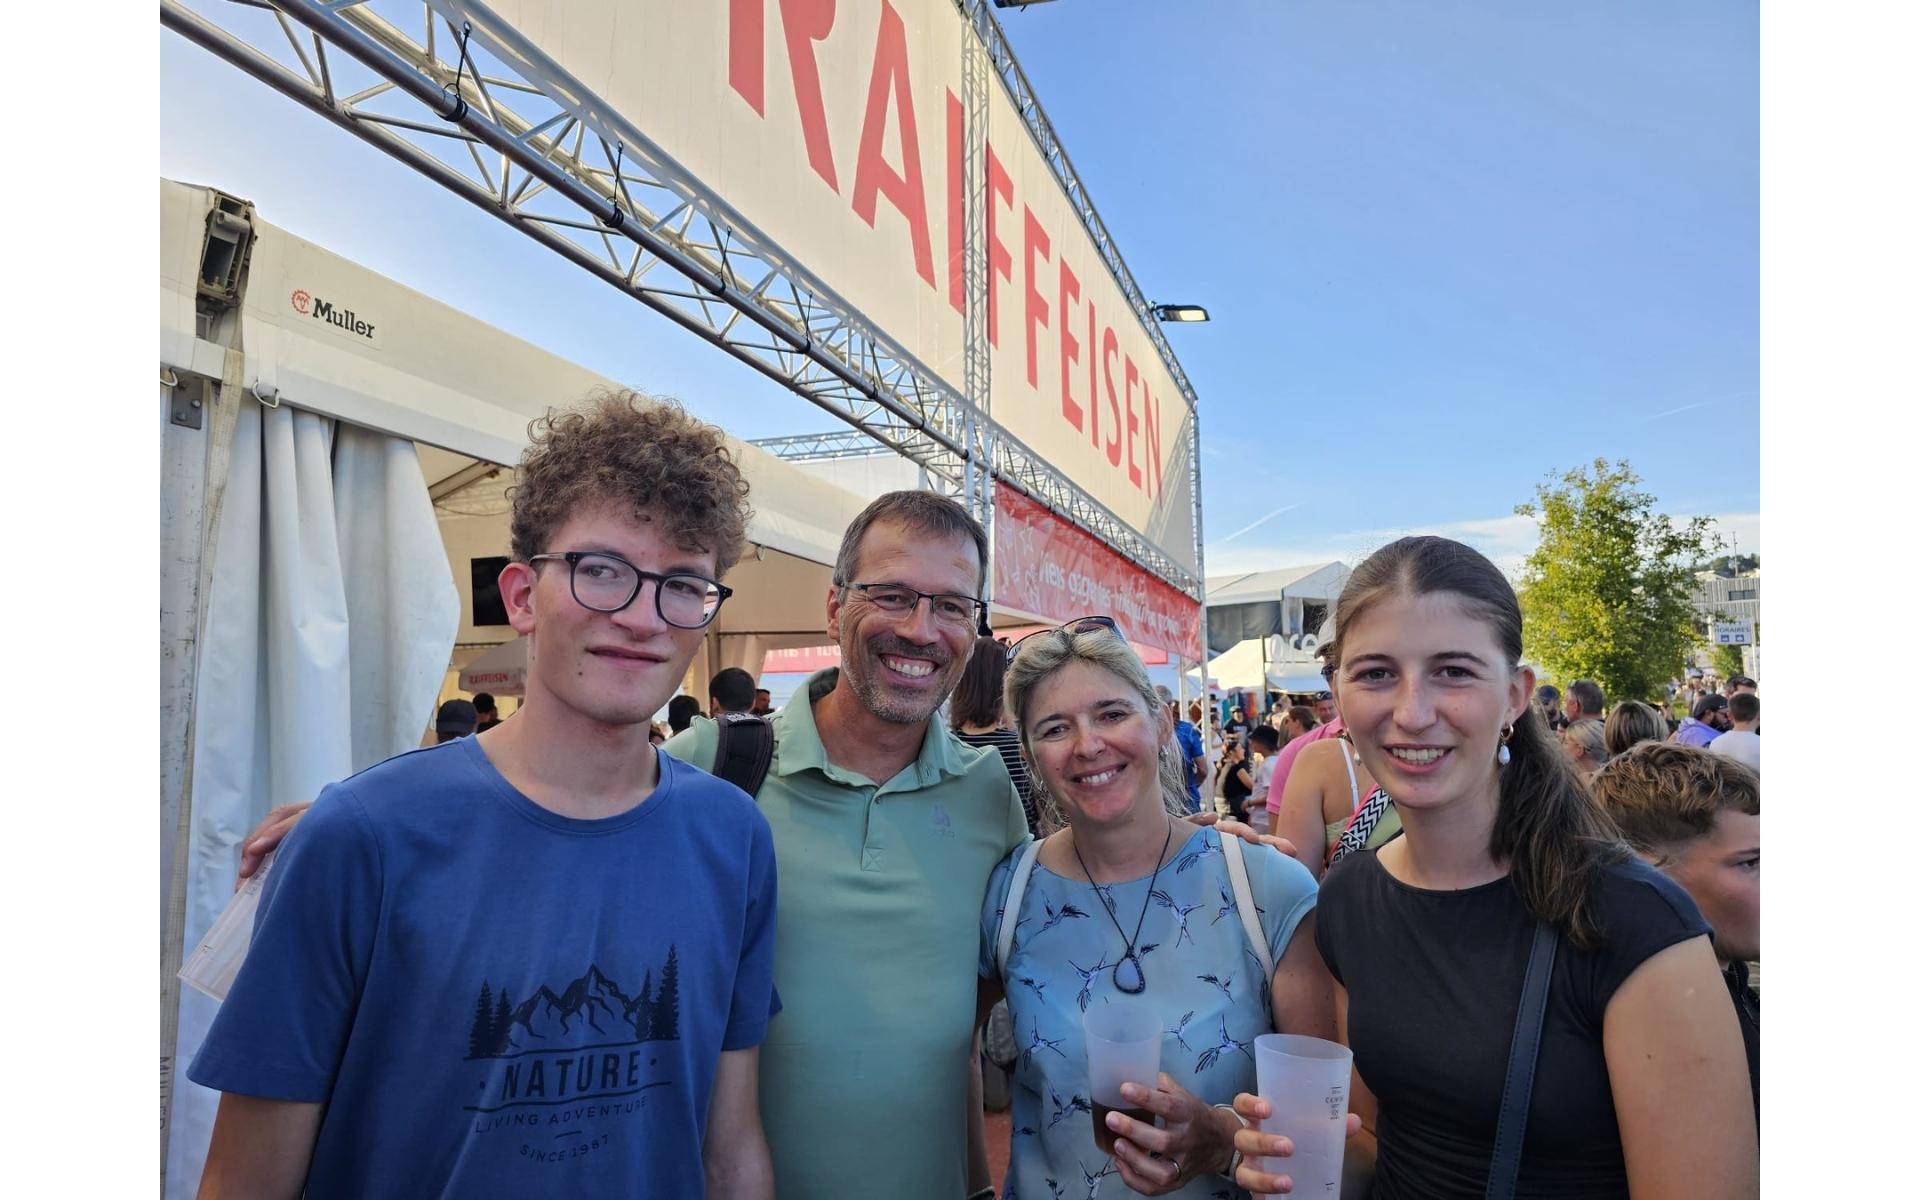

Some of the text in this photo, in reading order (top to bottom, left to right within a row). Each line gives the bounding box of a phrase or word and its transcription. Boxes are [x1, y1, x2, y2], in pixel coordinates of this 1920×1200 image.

[312, 297, 375, 339] Muller
[501, 1051, 641, 1101] NATURE
[476, 1096, 648, 1133] LIVING ADVENTURE
[520, 1134, 610, 1163] SINCE 1987
